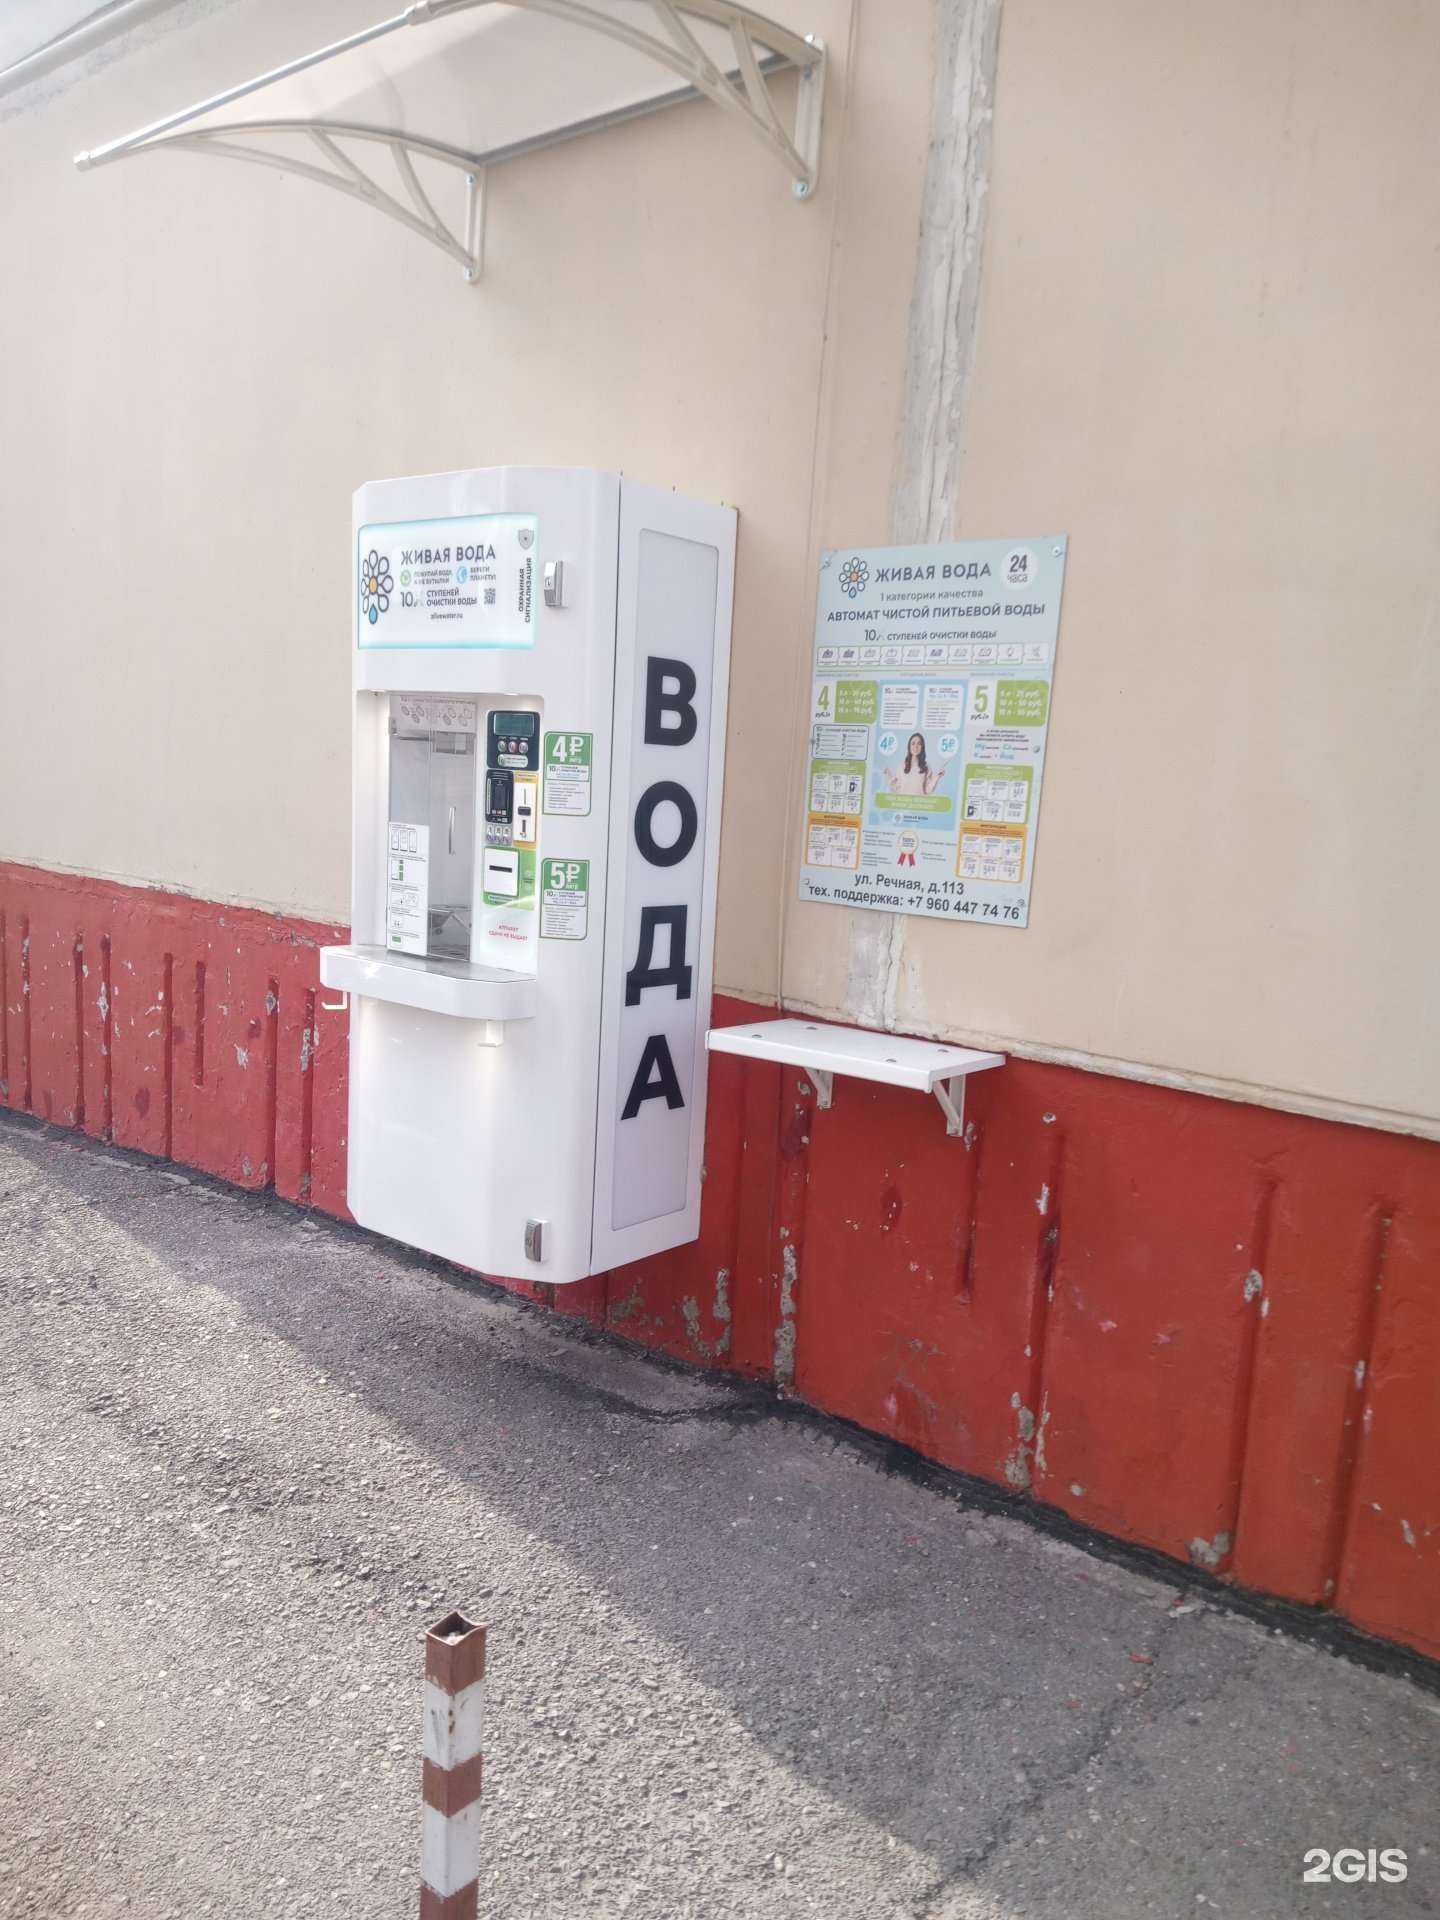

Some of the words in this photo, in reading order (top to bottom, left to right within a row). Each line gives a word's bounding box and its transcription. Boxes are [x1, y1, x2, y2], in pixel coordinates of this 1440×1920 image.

[400, 547, 450, 565] ЖИВАЯ
[456, 544, 496, 562] ВОДА
[1009, 554, 1028, 573] 24
[875, 565, 936, 583] ЖИВАЯ
[942, 562, 992, 580] ВОДА
[1007, 573, 1028, 583] часа
[426, 587, 460, 598] СТУПЕНЕЙ
[426, 598, 456, 607] ОЧИСТКИ
[457, 597, 478, 606] ВОДЫ
[886, 591, 936, 602] категории
[938, 589, 984, 600] качества
[827, 609, 881, 622] АВТОМАТ
[882, 605, 930, 620] ЧИСТОЙ
[932, 602, 1001, 618] ПИТЬЕВОЙ
[1004, 603, 1046, 617] ВОДЫ
[887, 630, 927, 641] СТУПЕНЕЙ
[929, 631, 968, 640] ОЧИСТКИ
[970, 630, 997, 640] ВОДЫ
[817, 685, 830, 711] 4
[974, 685, 989, 713] 5
[621, 655, 698, 1121] ВОДА
[854, 873, 873, 888] ул.
[876, 874, 925, 894] Речная,
[928, 883, 965, 896] д.113
[808, 884, 831, 897] тех.
[834, 888, 903, 907] поддержка:
[907, 896, 923, 908] +7
[926, 898, 950, 912] 960
[954, 900, 978, 914] 447
[983, 903, 998, 918] 74
[1003, 905, 1020, 920] 76
